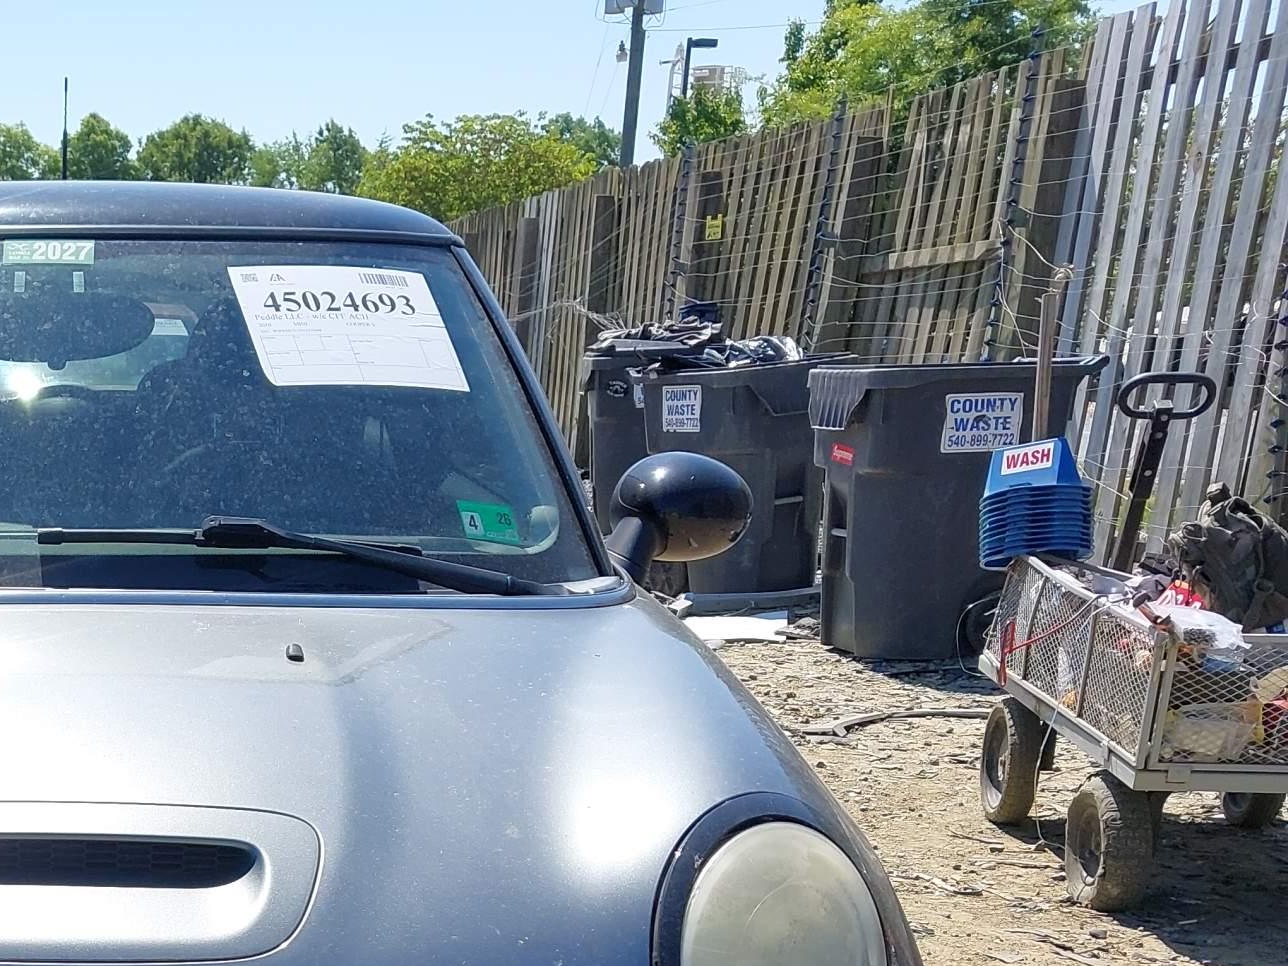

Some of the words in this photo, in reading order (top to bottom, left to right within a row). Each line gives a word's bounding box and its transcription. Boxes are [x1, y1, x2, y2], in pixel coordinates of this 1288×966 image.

[31, 241, 93, 261] 2027
[264, 291, 416, 316] 45024693
[665, 389, 699, 402] COUNTY
[667, 403, 696, 417] WASTE
[951, 397, 1018, 414] COUNTY
[954, 414, 1012, 432] WASTE
[947, 432, 1015, 448] 540-899-7722
[1006, 448, 1051, 470] WASH
[469, 514, 478, 530] 4
